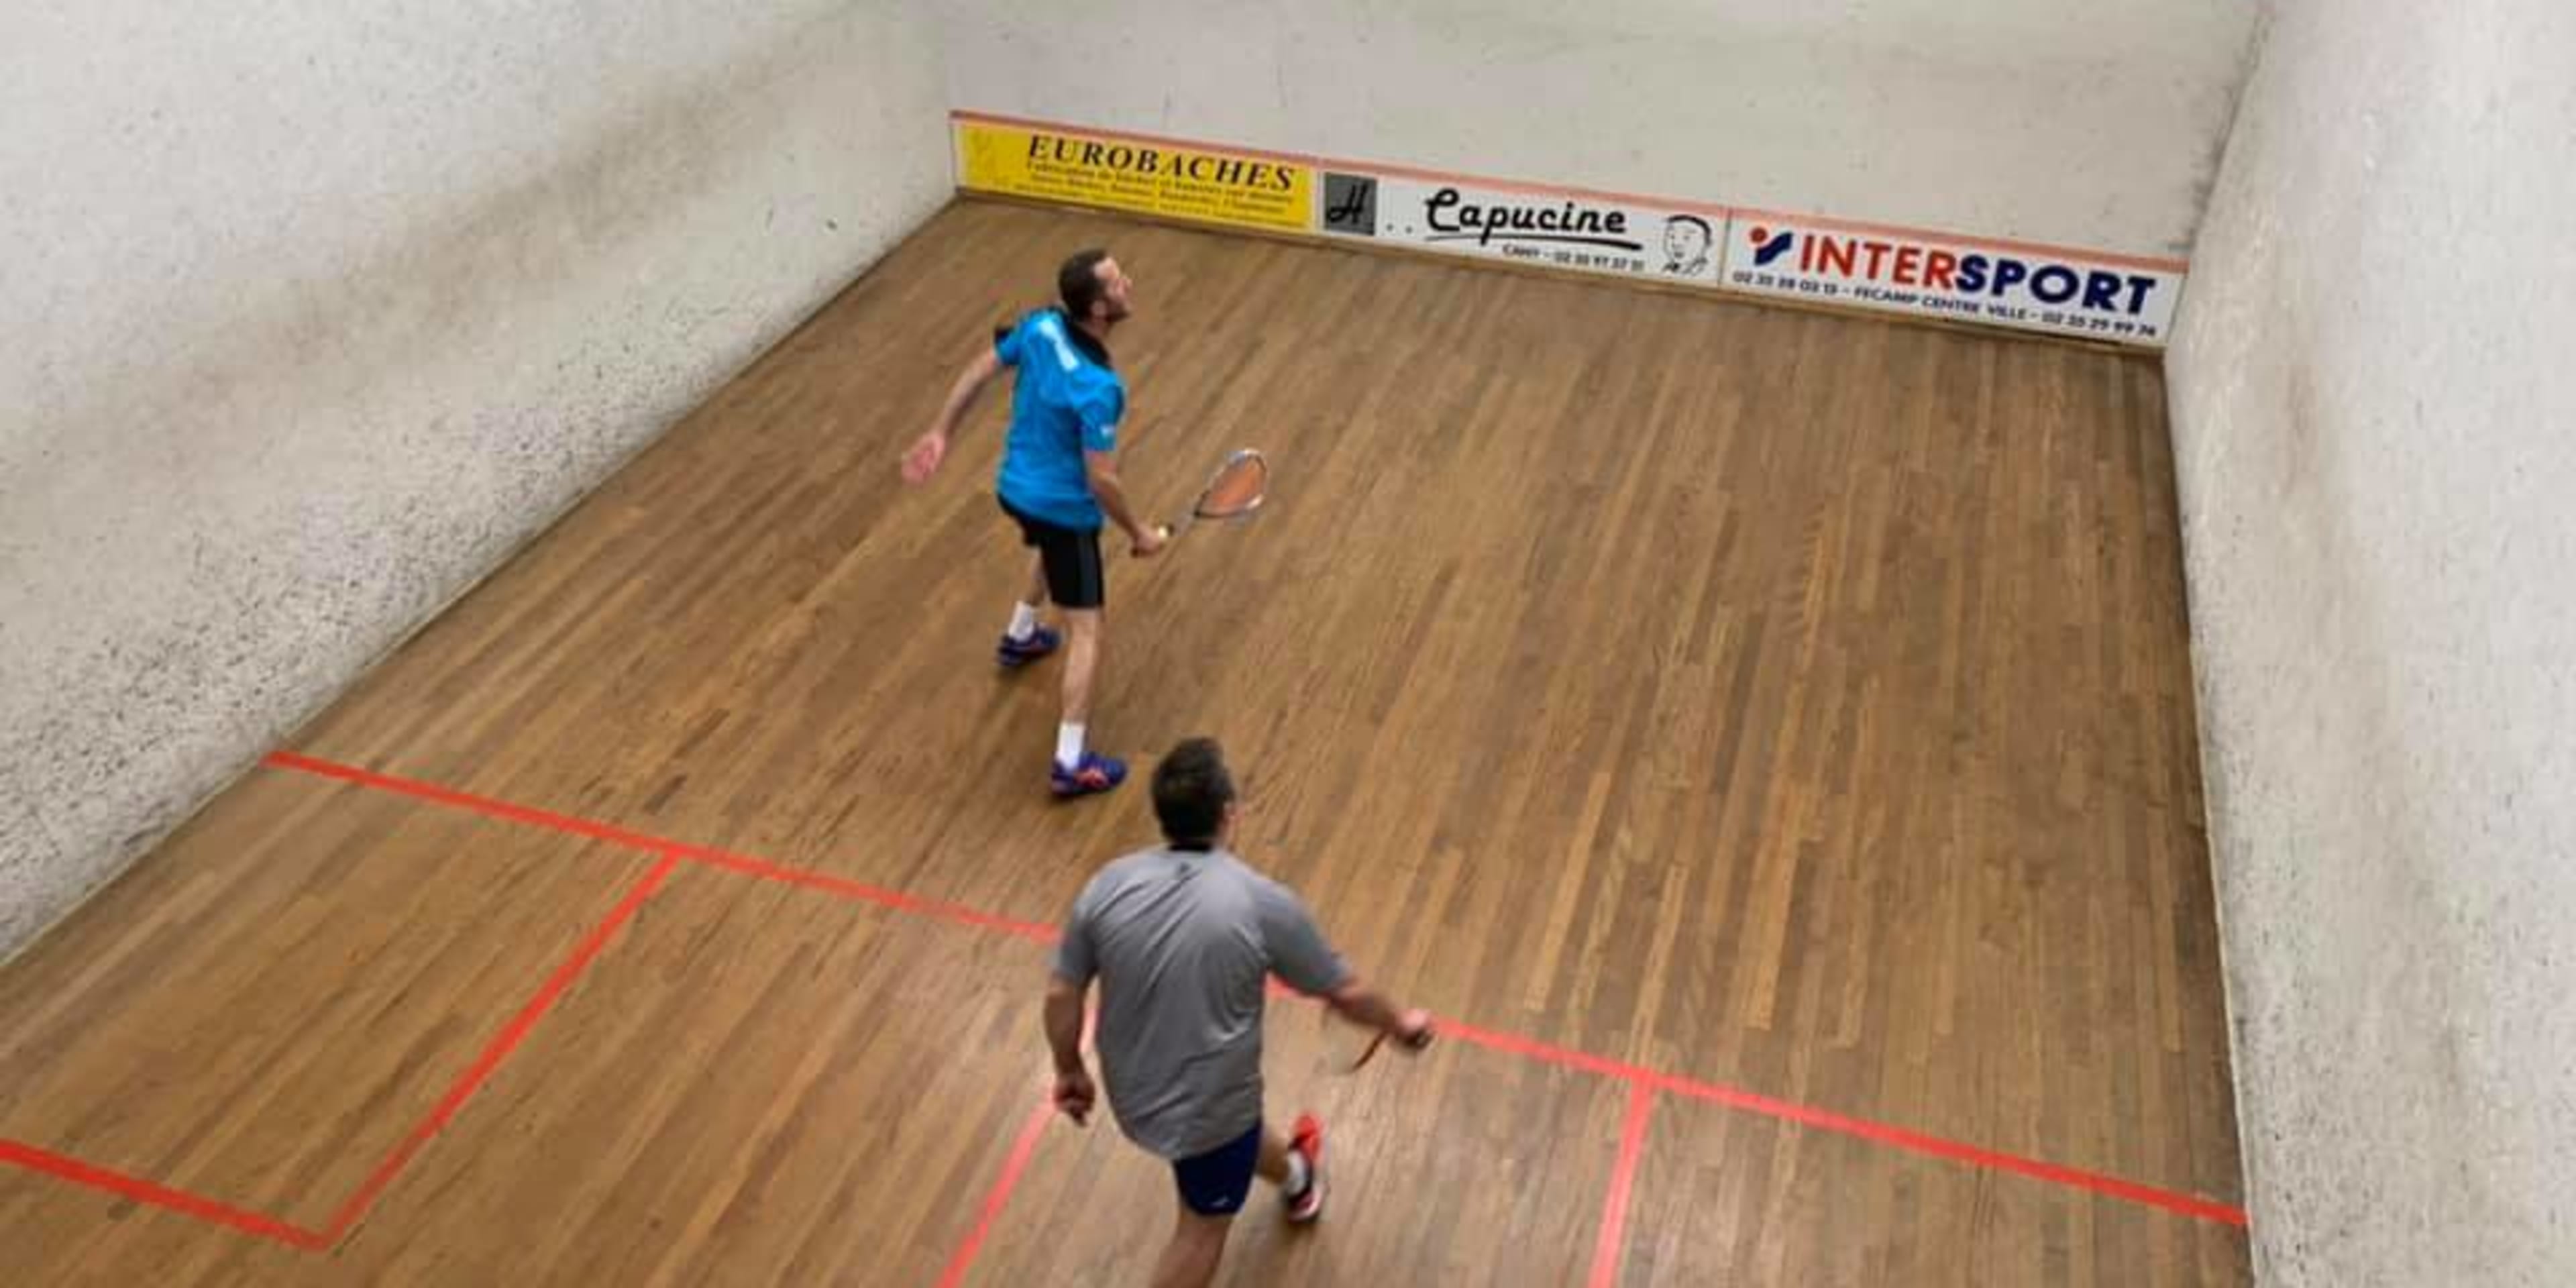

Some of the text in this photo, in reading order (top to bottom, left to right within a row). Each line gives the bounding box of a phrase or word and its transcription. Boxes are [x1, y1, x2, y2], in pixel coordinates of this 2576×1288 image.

[1029, 134, 1295, 191] EUROBACHES
[1424, 188, 1627, 246] Capucine
[1800, 235, 2155, 314] INTERSPORT
[1921, 296, 1980, 313] CENTRE
[1987, 303, 2027, 321] VILLE
